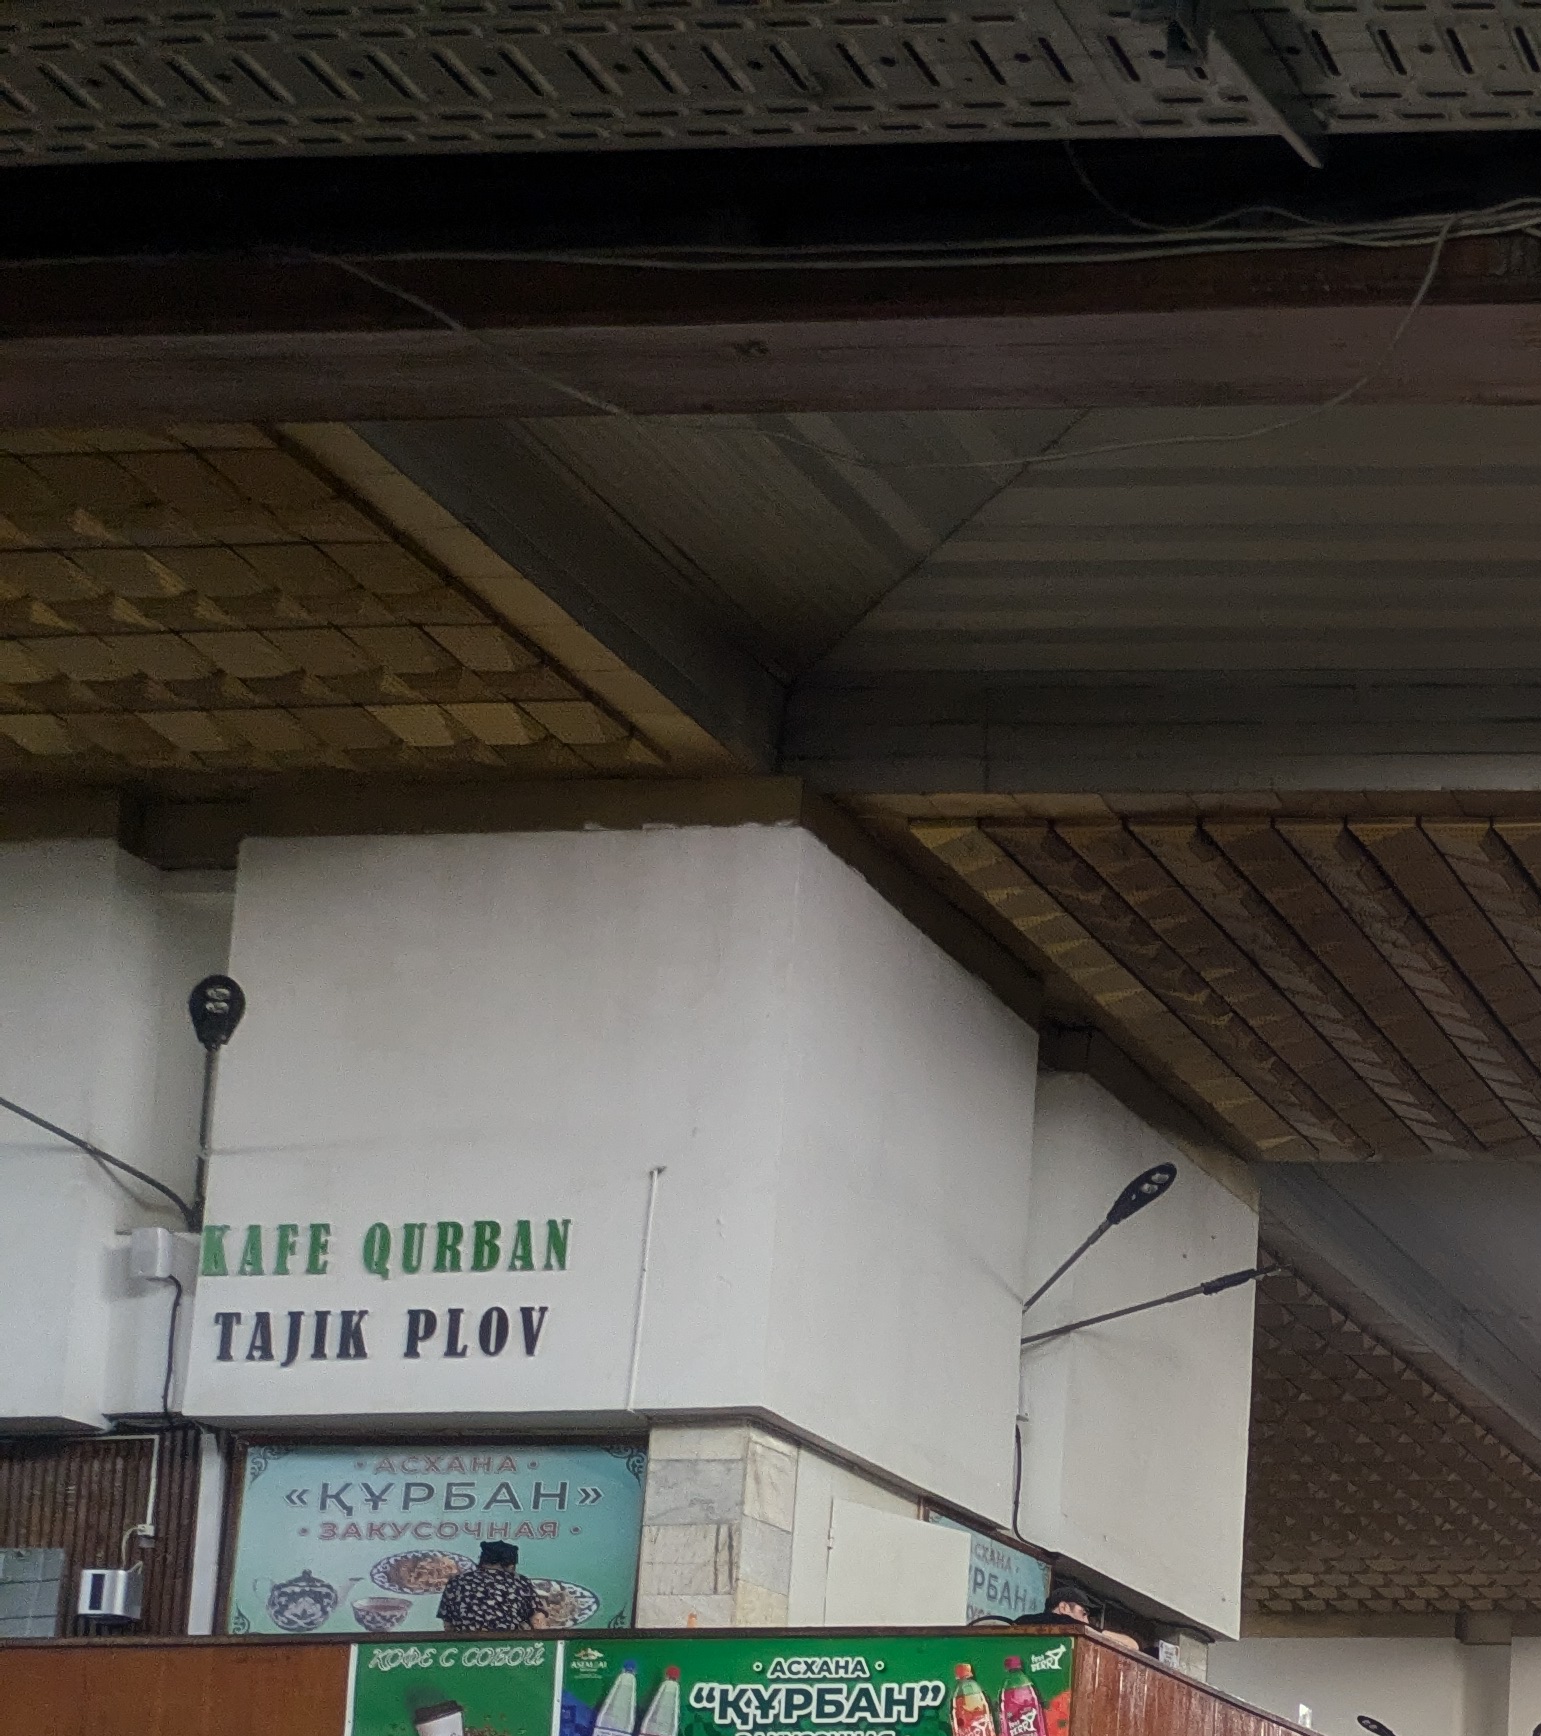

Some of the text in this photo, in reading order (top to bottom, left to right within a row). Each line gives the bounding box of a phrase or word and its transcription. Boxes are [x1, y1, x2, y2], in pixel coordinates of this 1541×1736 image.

[202, 1219, 572, 1281] KAFE QURBAN
[214, 1306, 550, 1368] TAJIK PLOV
[374, 1456, 520, 1476] АСХАНА
[318, 1520, 560, 1541] ЗАКУСОЧНАЯ
[369, 1647, 437, 1671] КОФЕ
[461, 1643, 546, 1667] СОБОЙ
[767, 1657, 870, 1679] АСХАНА
